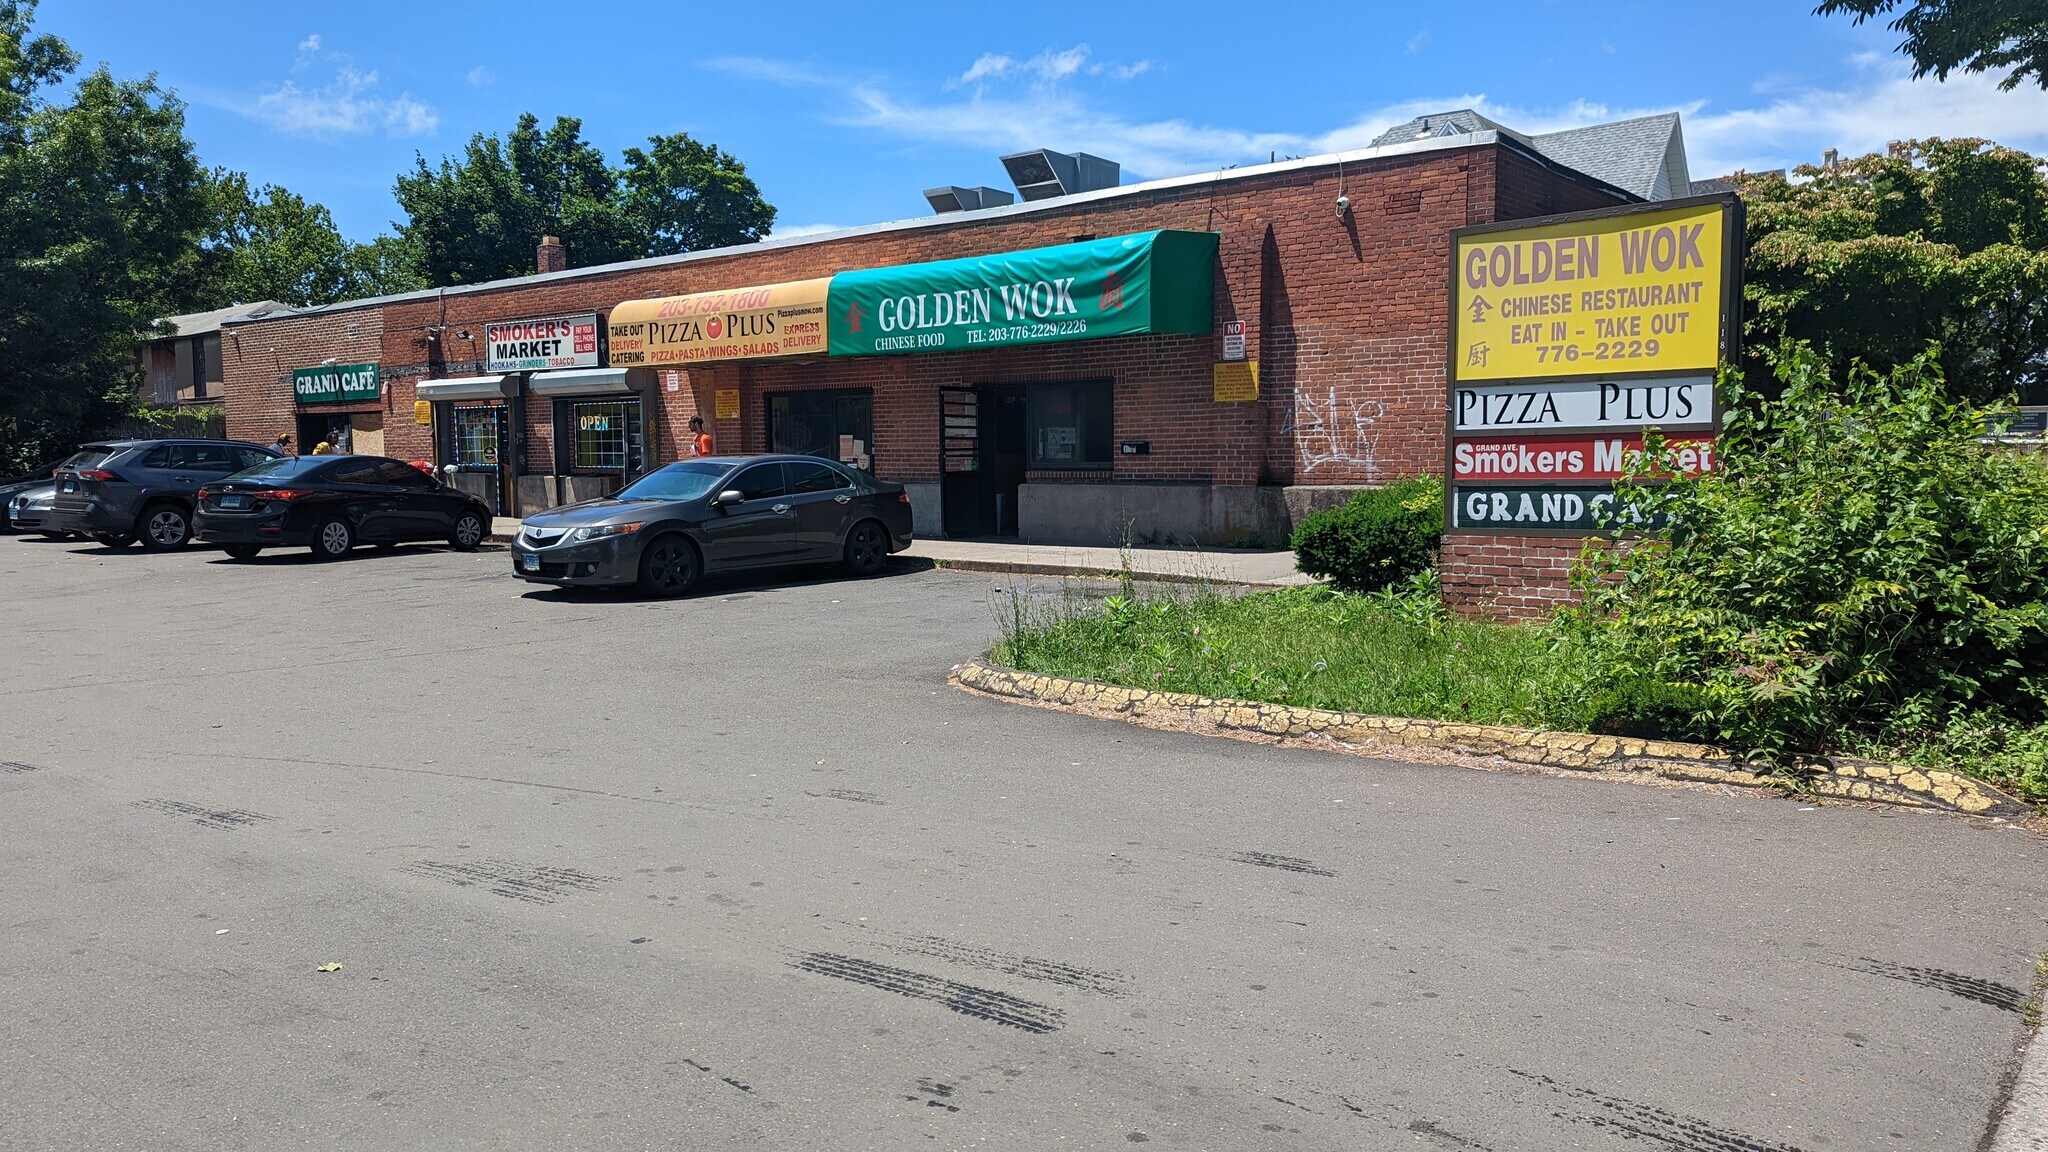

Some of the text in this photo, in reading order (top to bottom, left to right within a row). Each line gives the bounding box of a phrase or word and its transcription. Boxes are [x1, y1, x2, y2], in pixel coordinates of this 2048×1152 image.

[1466, 223, 1705, 289] GOLDEN WOK
[657, 289, 771, 319] 203-752-1800
[879, 287, 992, 332] GOLDEN
[1000, 277, 1078, 321] WOK
[1501, 282, 1703, 318] CHINESE RESTAURANT
[777, 306, 823, 318] Pizzaplusnow.com
[490, 320, 571, 343] SMOKER'S
[583, 325, 592, 334] YOUR
[611, 324, 644, 337] TAKE OUT
[648, 312, 775, 345] PIZZA PLUS
[784, 322, 820, 335] EXPRESS
[875, 319, 1087, 352] CHINESE FOOD TEL: 203-776-2229/2226
[1227, 323, 1241, 334] NO
[1511, 323, 1542, 344] EAT
[1551, 321, 1566, 342] IN
[1595, 315, 1641, 338] TAKE
[1651, 312, 1689, 335] OUT
[496, 339, 561, 359] MARKET
[611, 340, 644, 351] DELIVERY
[783, 335, 821, 348] DELIVERY
[1536, 339, 1660, 363] 776-2229
[611, 351, 645, 364] CATERING
[296, 366, 375, 394] GRAND CAFÉ
[1457, 383, 1693, 425] PIZZA PLUS
[581, 415, 608, 430] OPEN
[1455, 442, 1584, 475] Smokers
[1502, 443, 1518, 451] AVE.
[1466, 492, 1584, 523] GRAND
